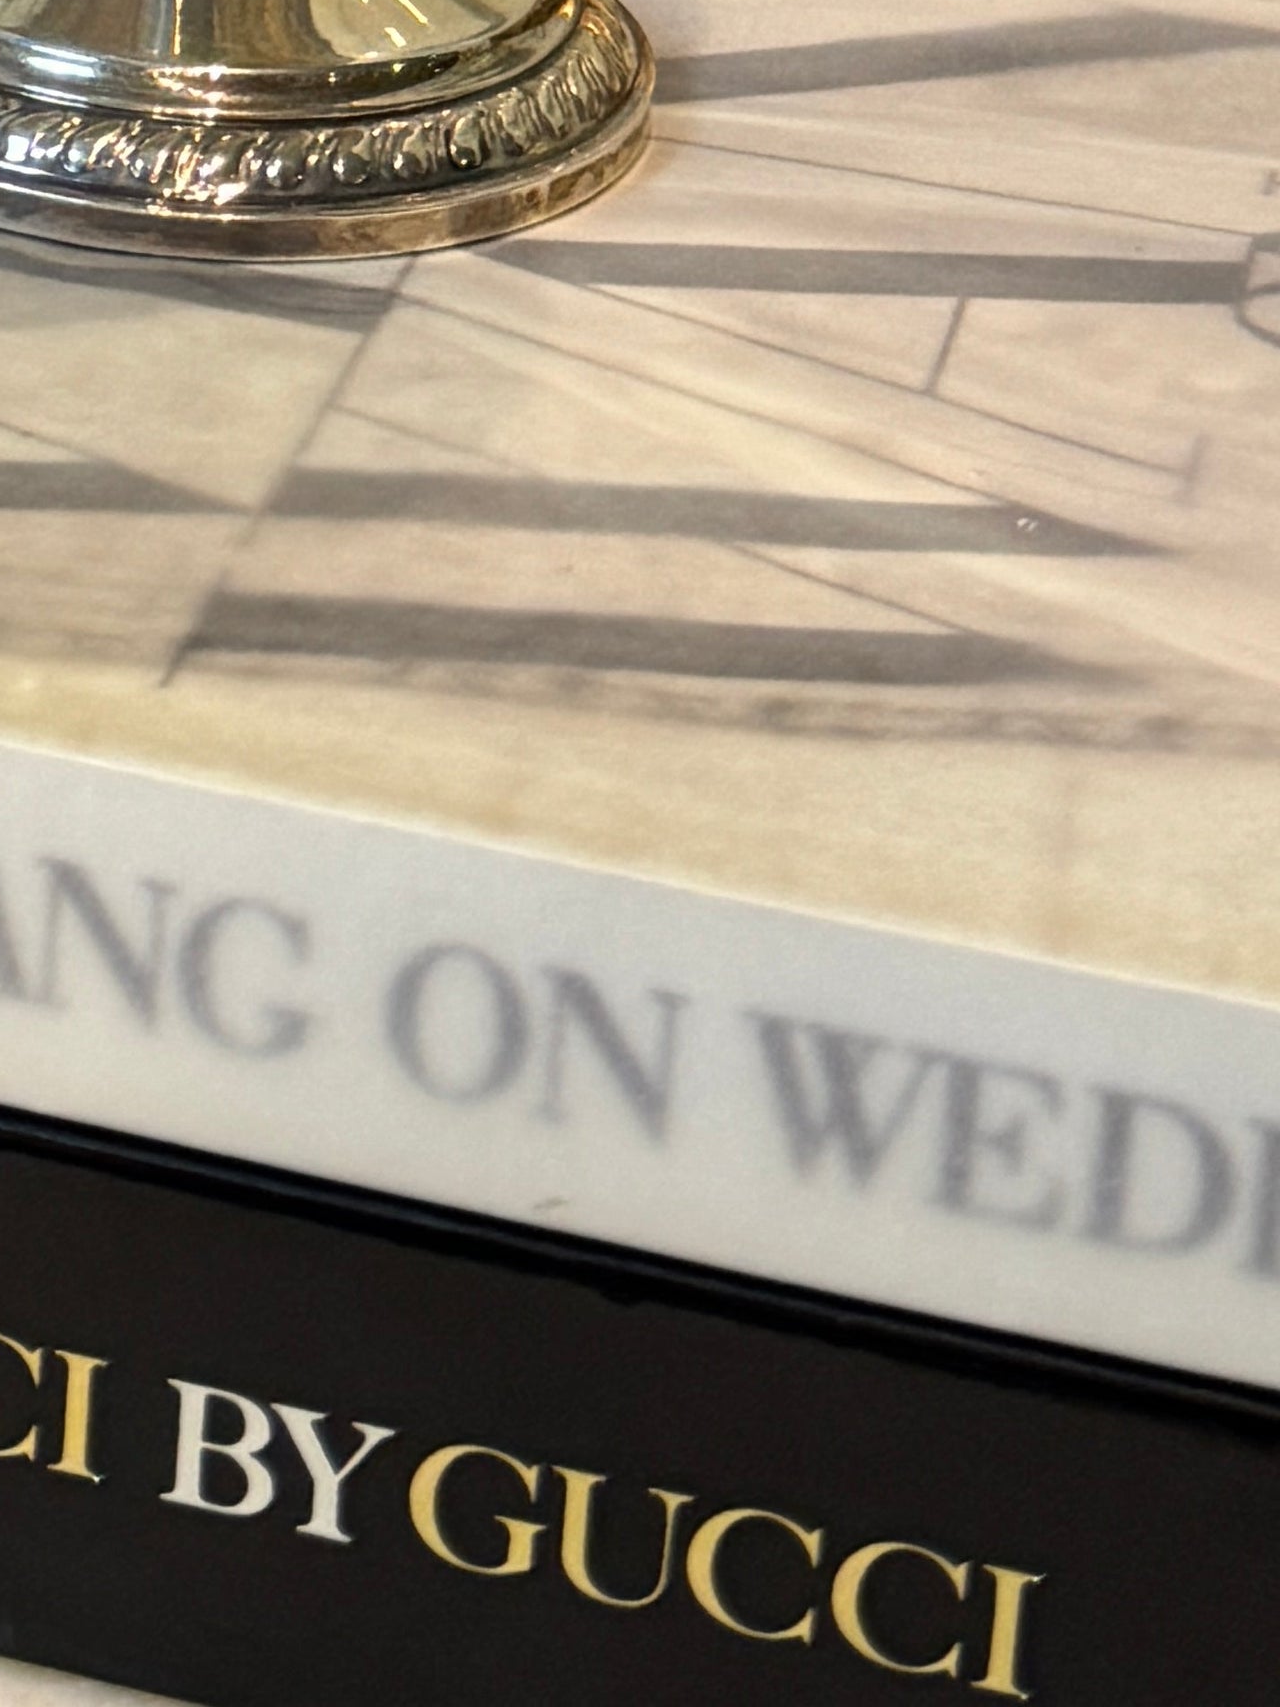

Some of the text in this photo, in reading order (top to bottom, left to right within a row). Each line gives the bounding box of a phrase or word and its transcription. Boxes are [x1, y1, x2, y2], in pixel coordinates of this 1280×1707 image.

[383, 942, 692, 1154] ON
[744, 1003, 1280, 1281] WED
[159, 1378, 396, 1543] BY
[409, 1444, 1043, 1700] GUCCI
